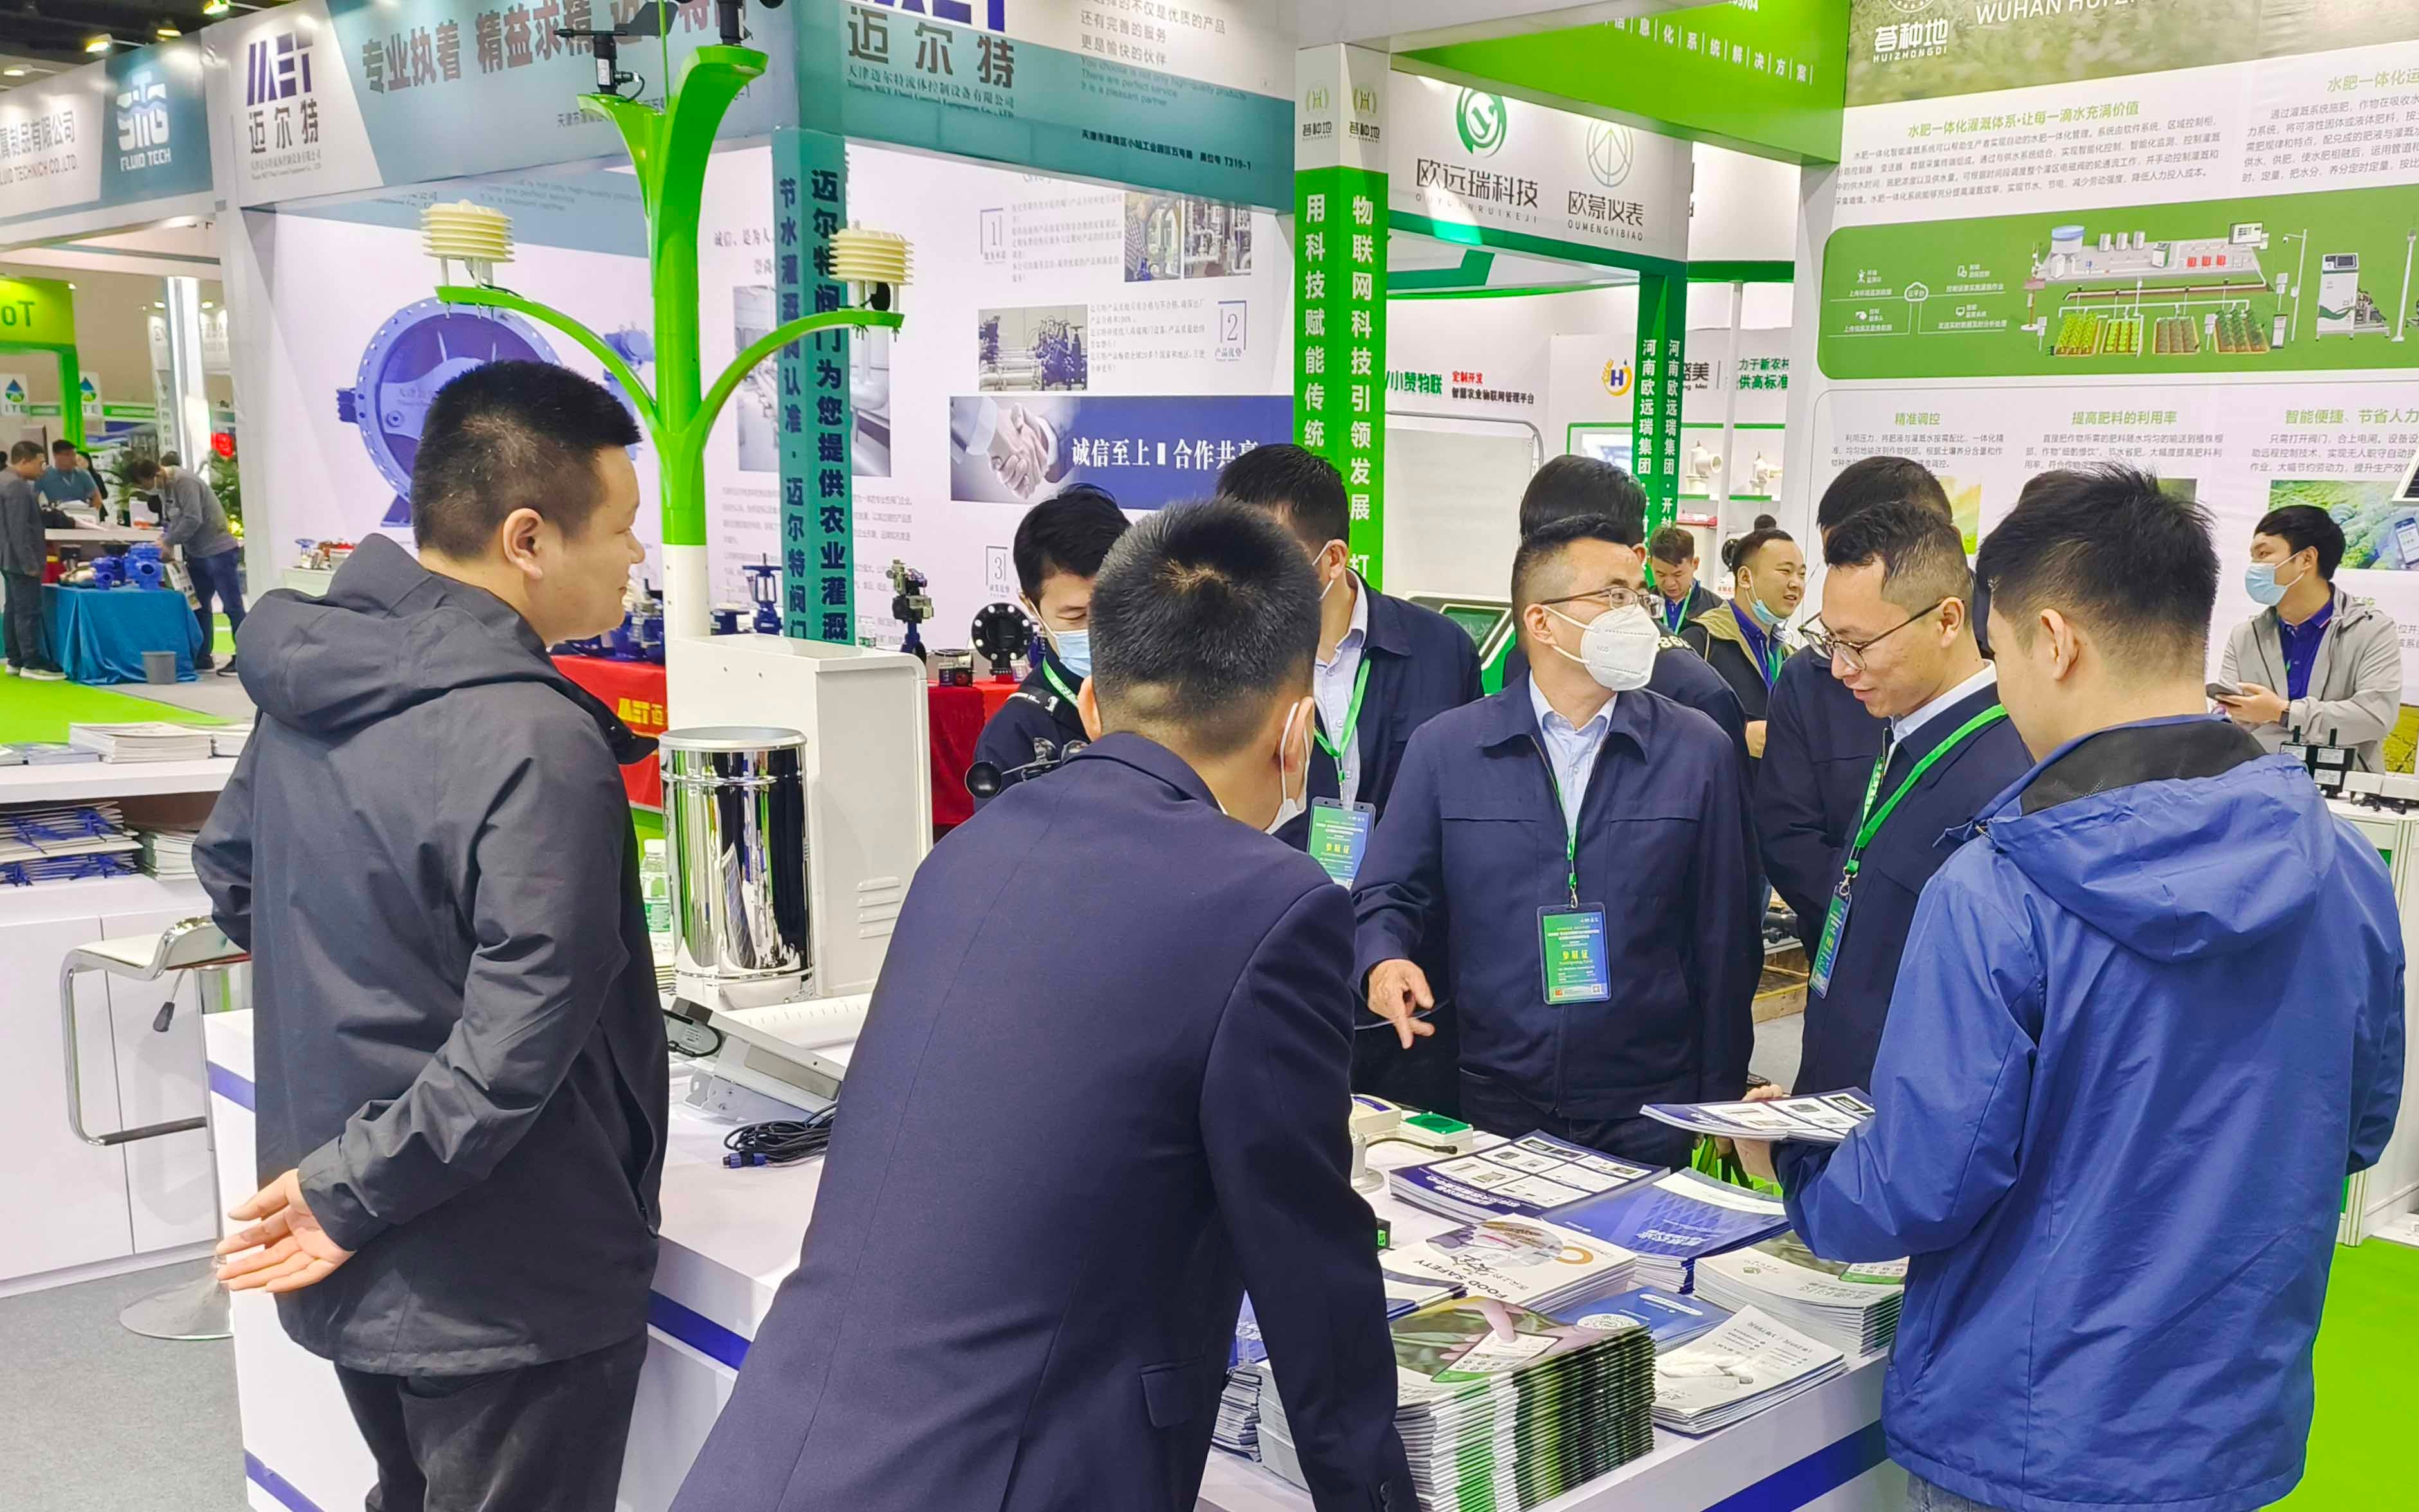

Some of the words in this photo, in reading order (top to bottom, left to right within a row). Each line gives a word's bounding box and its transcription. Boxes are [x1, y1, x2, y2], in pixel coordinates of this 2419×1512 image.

[1975, 0, 2062, 25] WUHAN
[1081, 10, 1167, 44] 还有完善的服务
[363, 19, 462, 94] 专业执着
[848, 6, 1014, 89] 迈尔特
[1873, 47, 1948, 64] HUIZHONGDI
[249, 98, 319, 154] 迈尔特
[1416, 158, 1539, 209] 欧远瑞科技
[1567, 190, 1645, 228] 欧蒙仪表
[1227, 313, 1239, 340] 2
[1304, 194, 1326, 449] 用科技赋能传统
[1349, 195, 1374, 521] 物联网科技引领发展
[1452, 371, 1484, 384] 定制开发
[1452, 387, 1534, 405] 智慧农业物联网管理平台
[1895, 412, 1941, 426] 精准调控
[2072, 410, 2178, 426] 提高肥料的利用率
[1071, 438, 1151, 467] 诚信至上
[994, 556, 1003, 579] 3
[1413, 1258, 1469, 1282] SAFETY
[1470, 1279, 1509, 1299] FOOD
